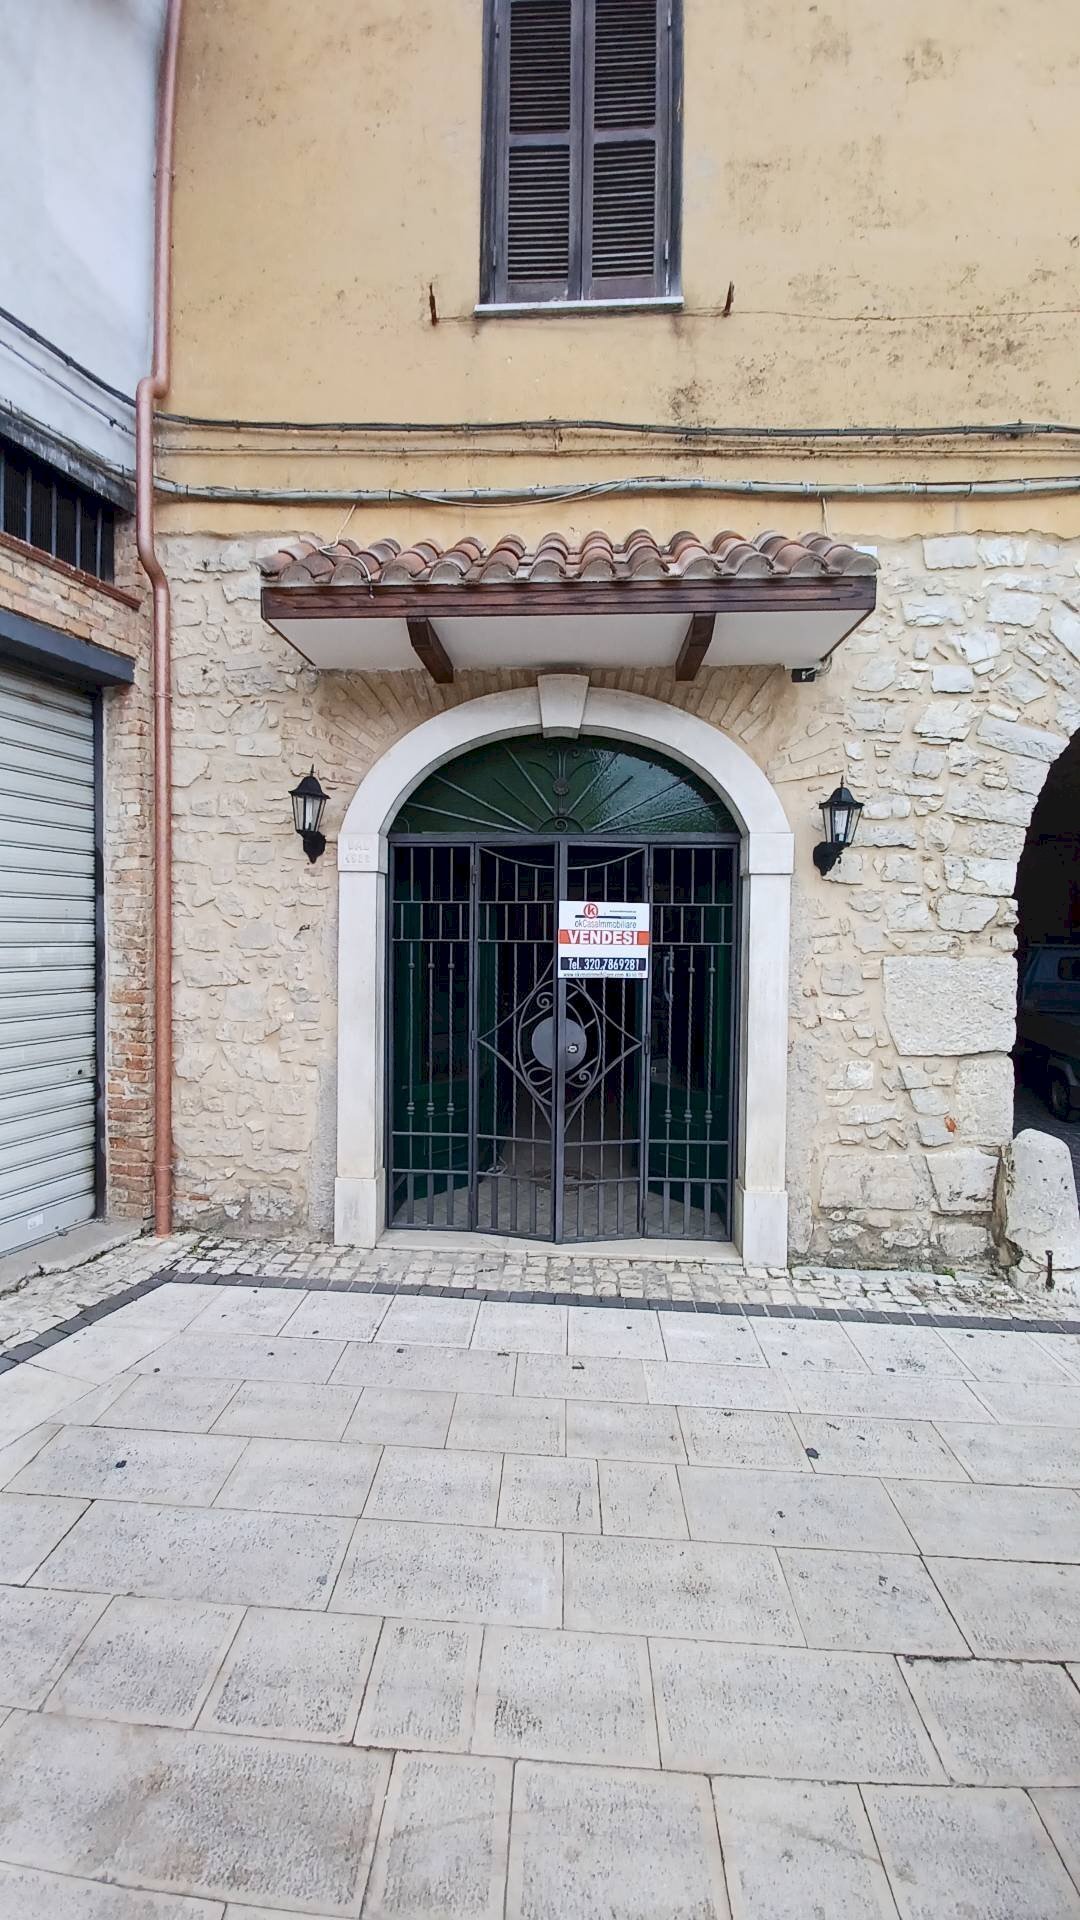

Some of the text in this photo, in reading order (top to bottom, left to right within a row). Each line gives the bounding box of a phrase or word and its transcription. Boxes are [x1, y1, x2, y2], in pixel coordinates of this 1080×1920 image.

[567, 930, 638, 945] VENDESI
[568, 958, 640, 971] Tel. 320.7869281
